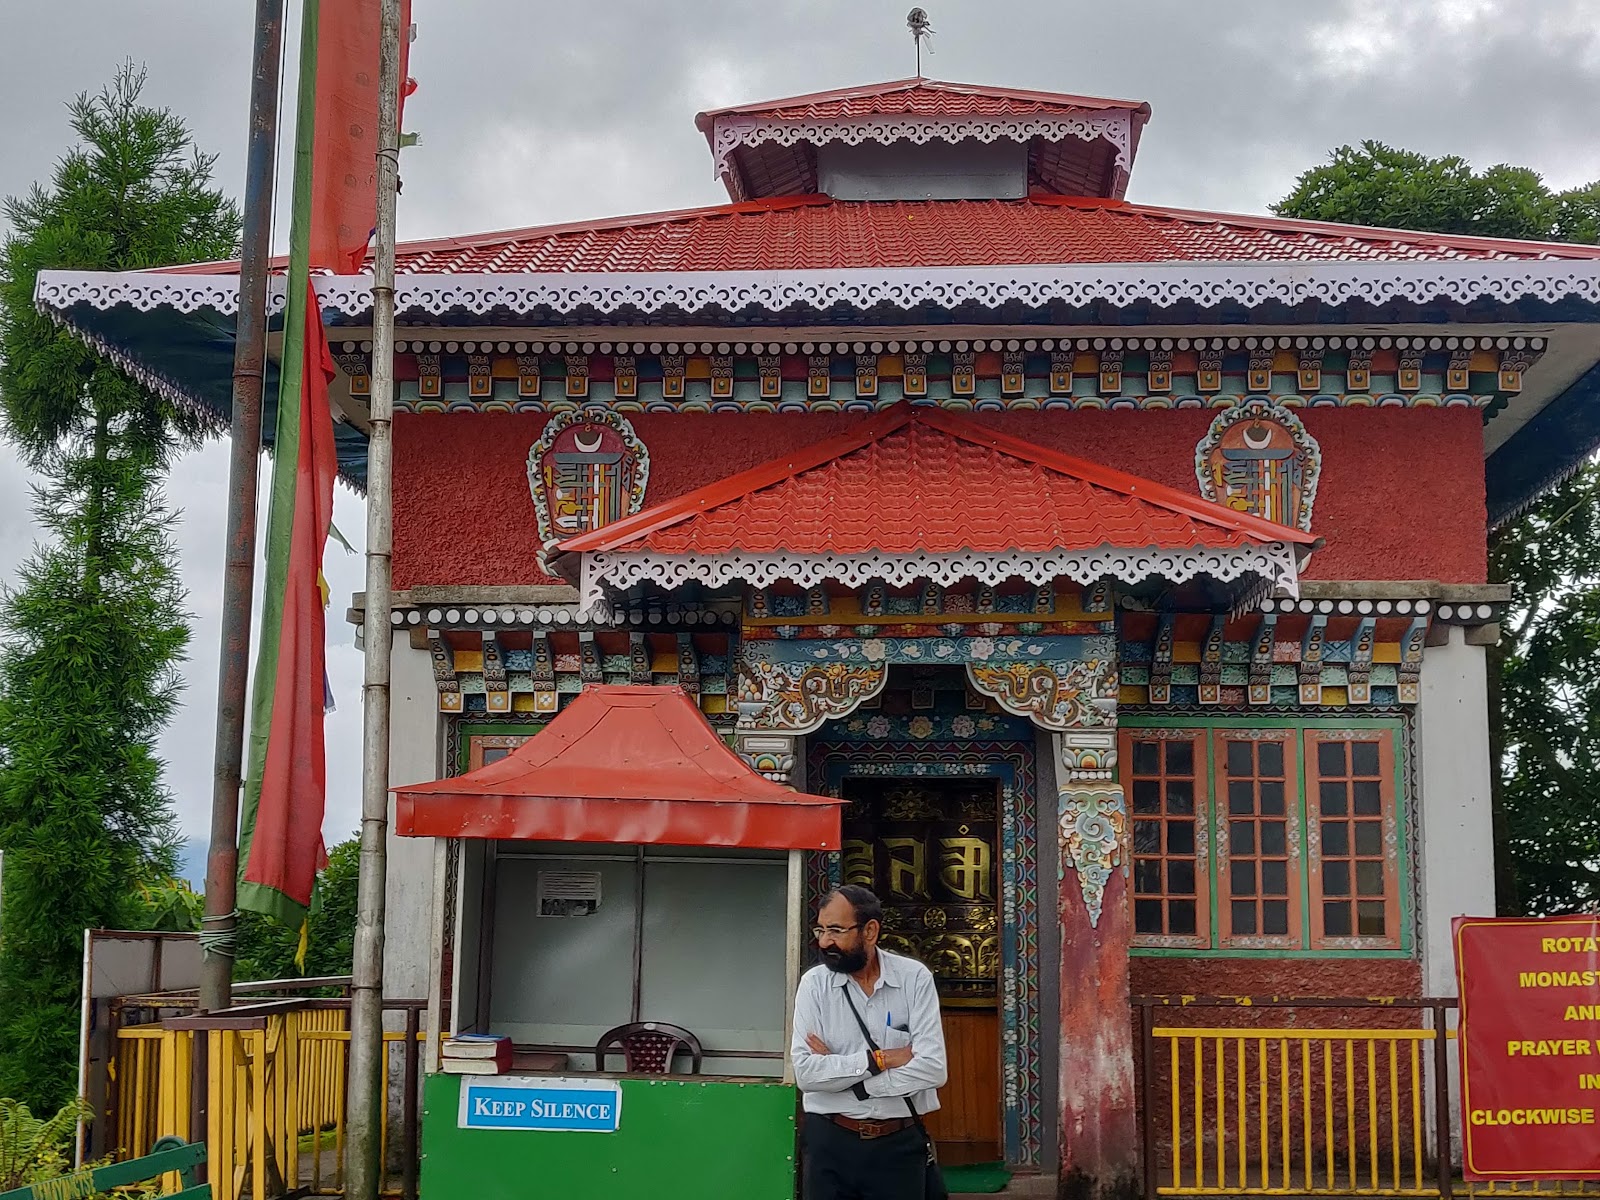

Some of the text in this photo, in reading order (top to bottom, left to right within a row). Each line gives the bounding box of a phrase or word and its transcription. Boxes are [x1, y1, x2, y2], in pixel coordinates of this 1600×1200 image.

[1507, 1040, 1591, 1056] PRAYER
[474, 1097, 611, 1120] KEEP SILENCE
[1471, 1108, 1595, 1126] CLOCKWISE
